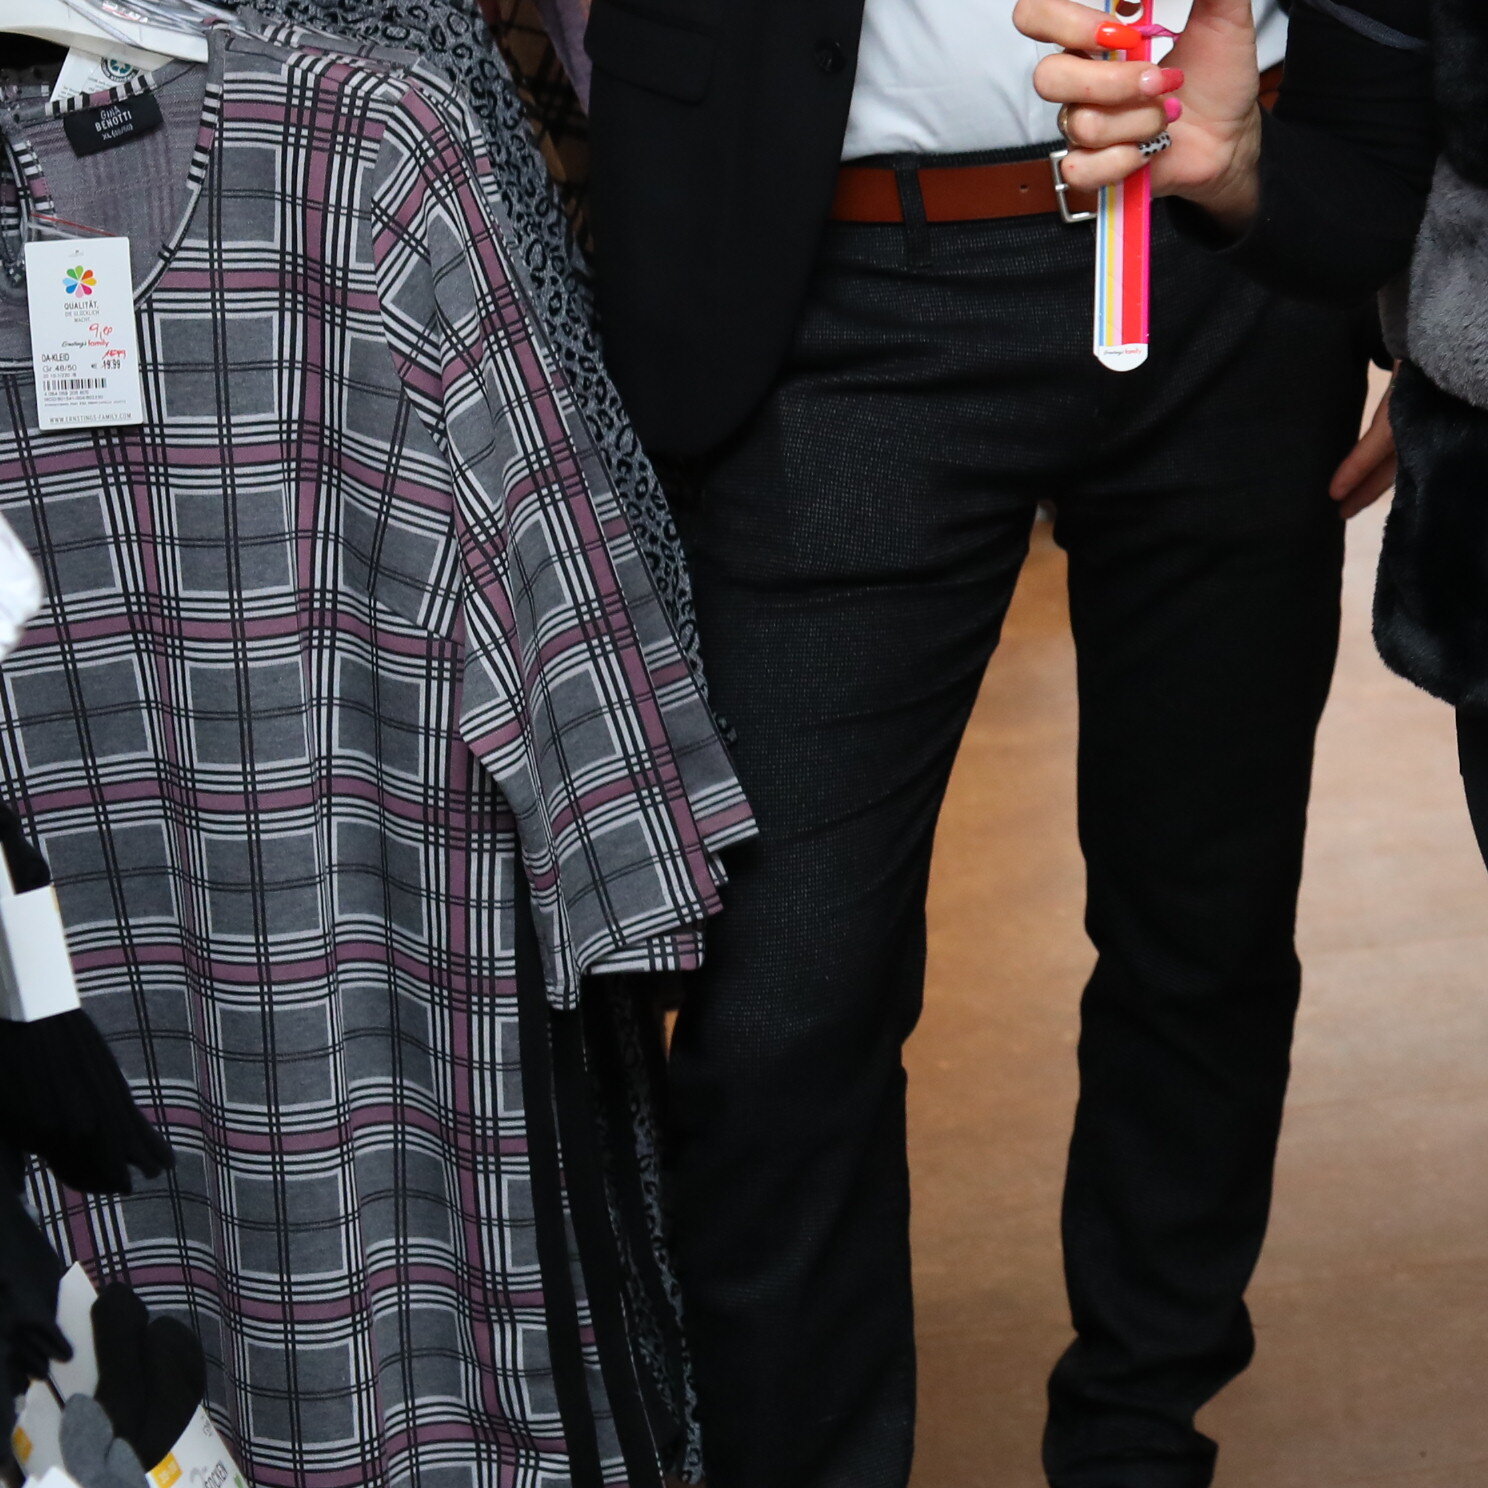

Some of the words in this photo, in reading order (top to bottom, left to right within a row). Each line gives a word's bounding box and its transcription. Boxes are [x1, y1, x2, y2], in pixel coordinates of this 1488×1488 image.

[100, 105, 121, 120] GINA
[94, 110, 133, 133] BENOTTI
[41, 353, 70, 362] DA-KLEID
